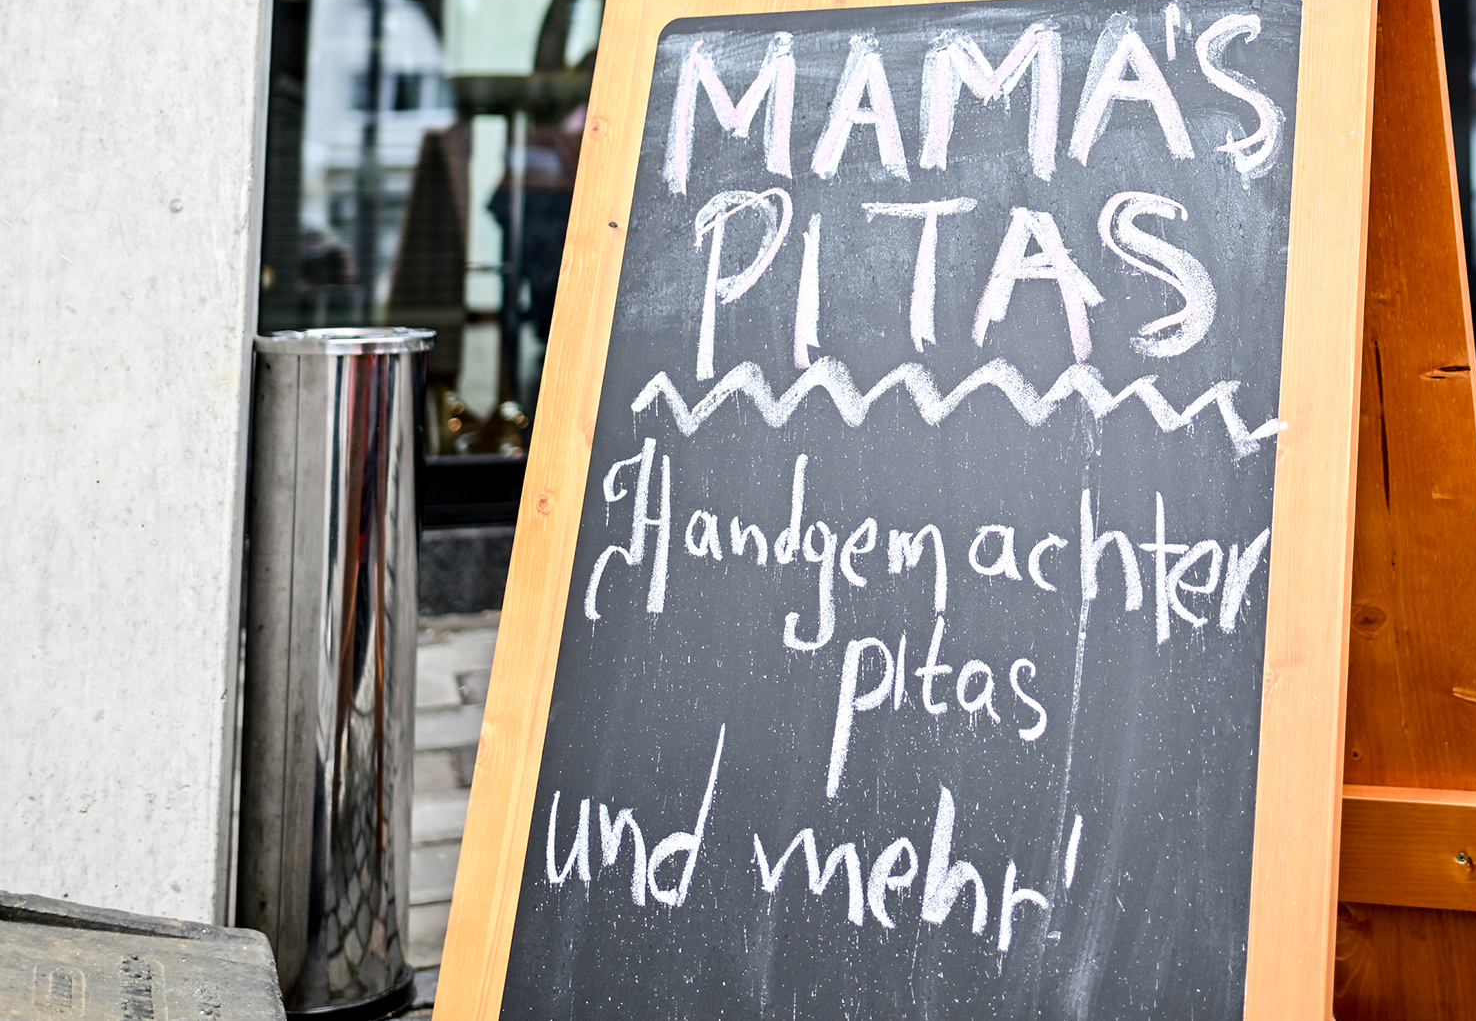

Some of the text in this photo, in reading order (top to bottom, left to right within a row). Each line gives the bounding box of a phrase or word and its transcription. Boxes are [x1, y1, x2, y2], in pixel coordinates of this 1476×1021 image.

[694, 187, 1217, 381] PITAS
[584, 438, 1271, 650] Handgemachter
[546, 722, 725, 907] und
